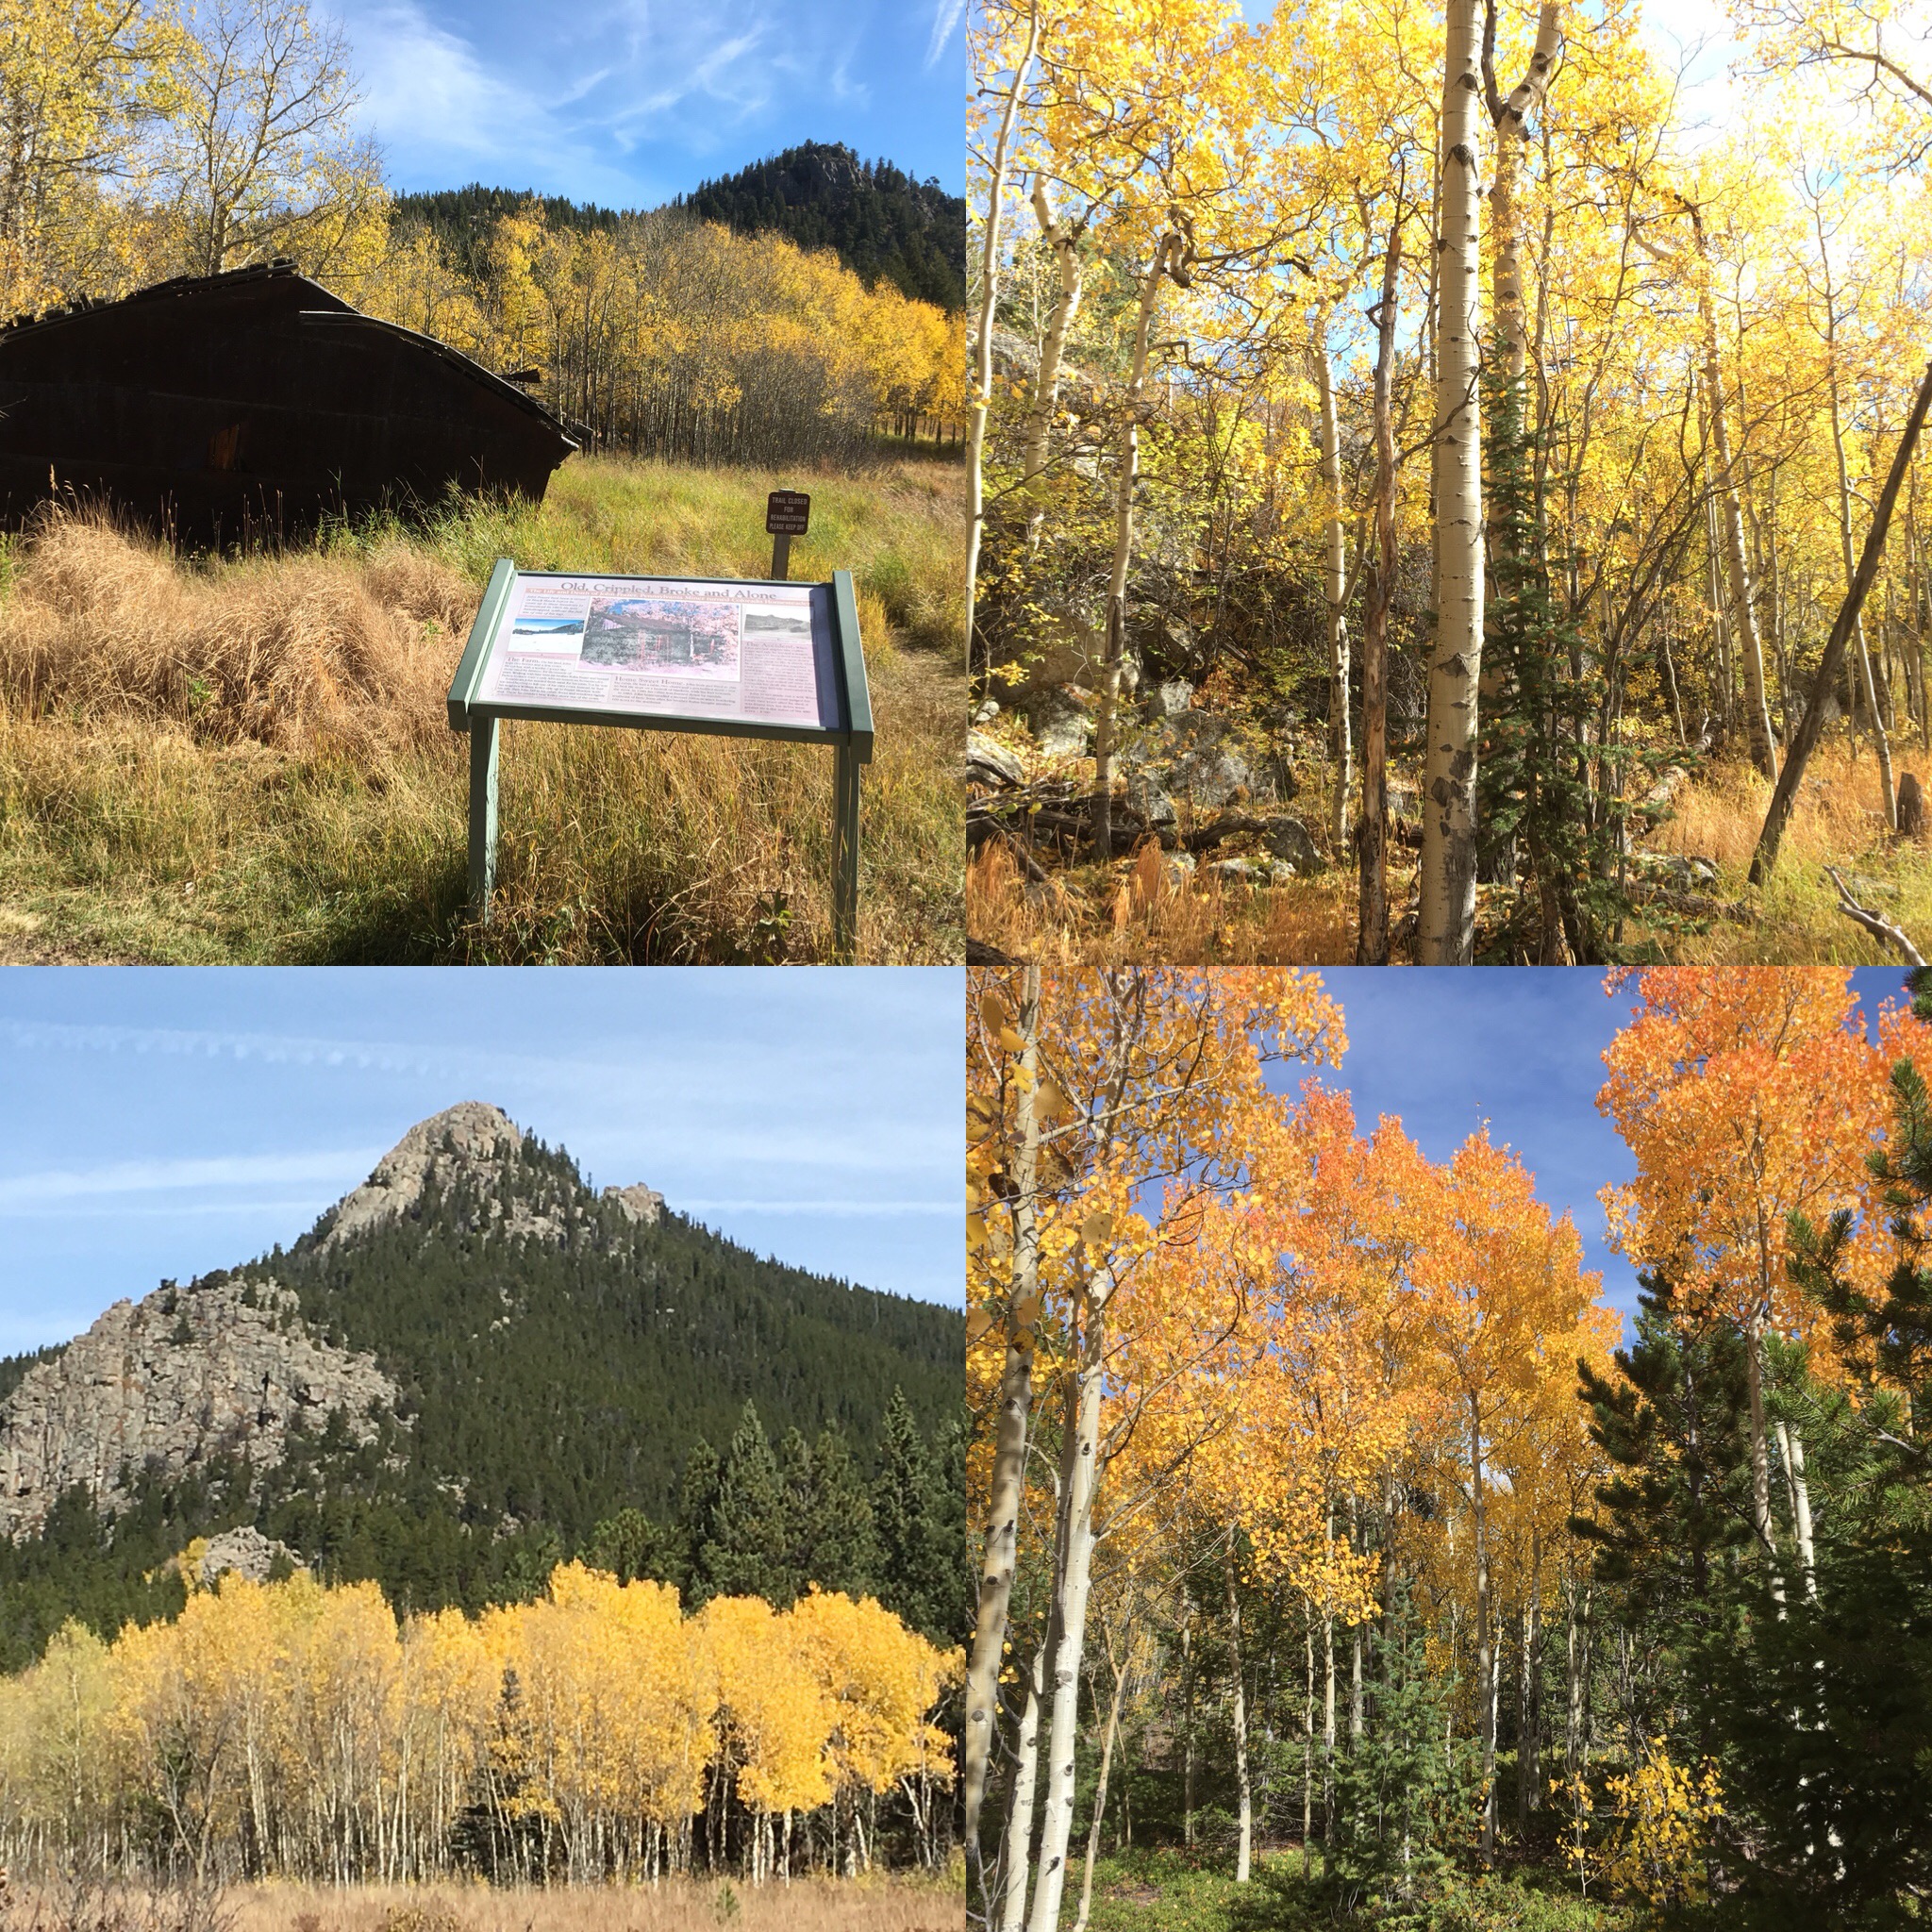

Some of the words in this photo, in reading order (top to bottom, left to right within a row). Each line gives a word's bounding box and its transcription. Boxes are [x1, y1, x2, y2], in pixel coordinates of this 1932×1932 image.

[560, 582, 589, 591] Old,
[593, 583, 655, 594] Crippled,
[659, 586, 700, 596] Broke
[704, 589, 729, 597] and
[735, 590, 776, 600] Alone
